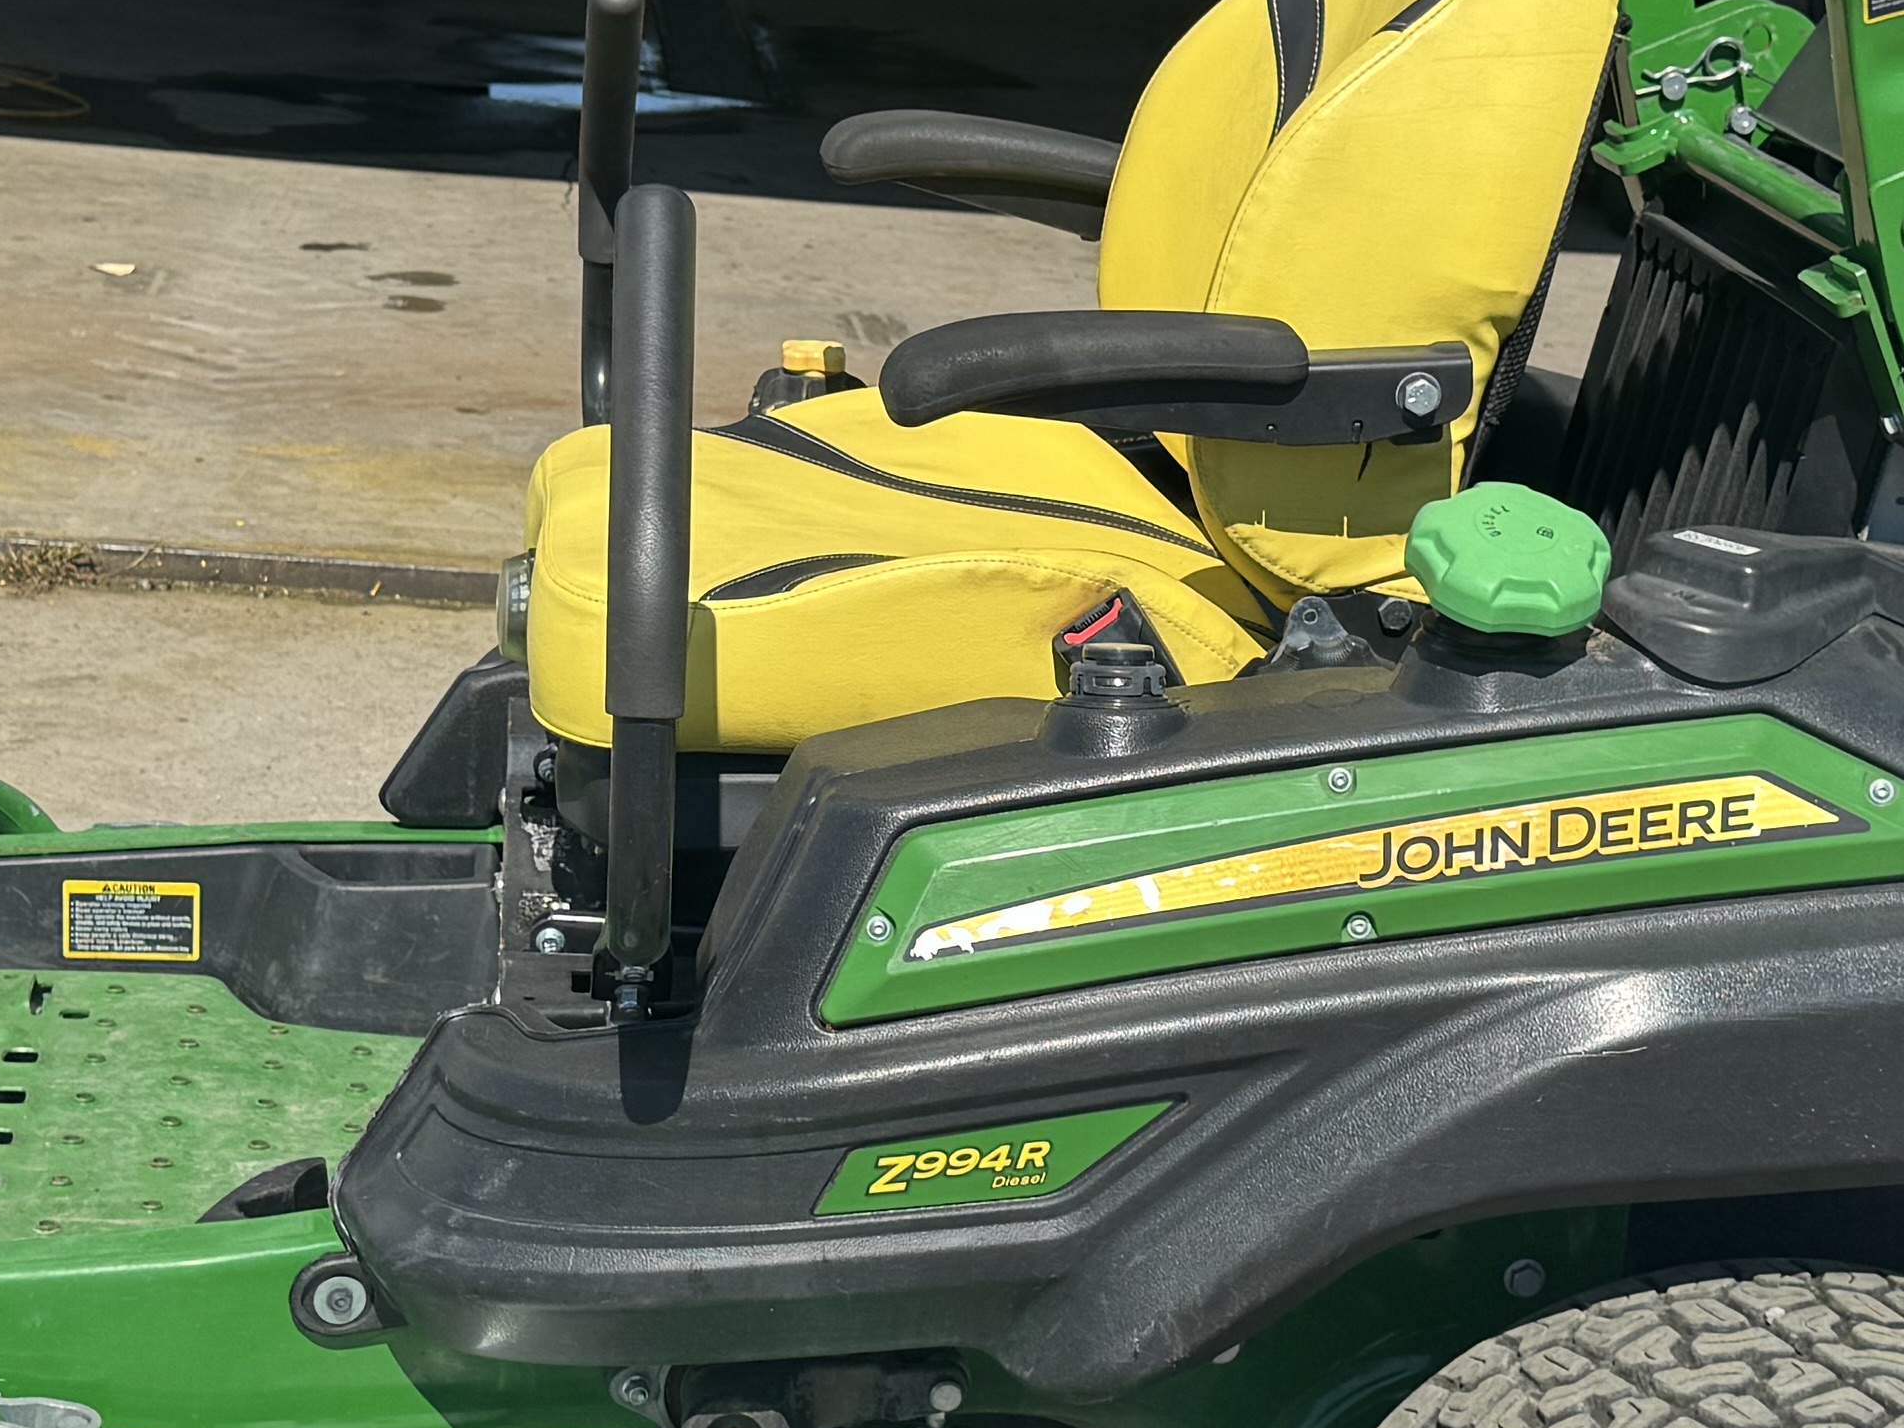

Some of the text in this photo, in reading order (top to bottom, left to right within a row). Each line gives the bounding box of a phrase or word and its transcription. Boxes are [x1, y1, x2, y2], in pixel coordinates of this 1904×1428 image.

[1359, 793, 1756, 882] JOHN DEERE
[112, 884, 155, 893] CAUTION
[867, 1140, 1052, 1196] Z994R
[991, 1172, 1047, 1189] Diesel
